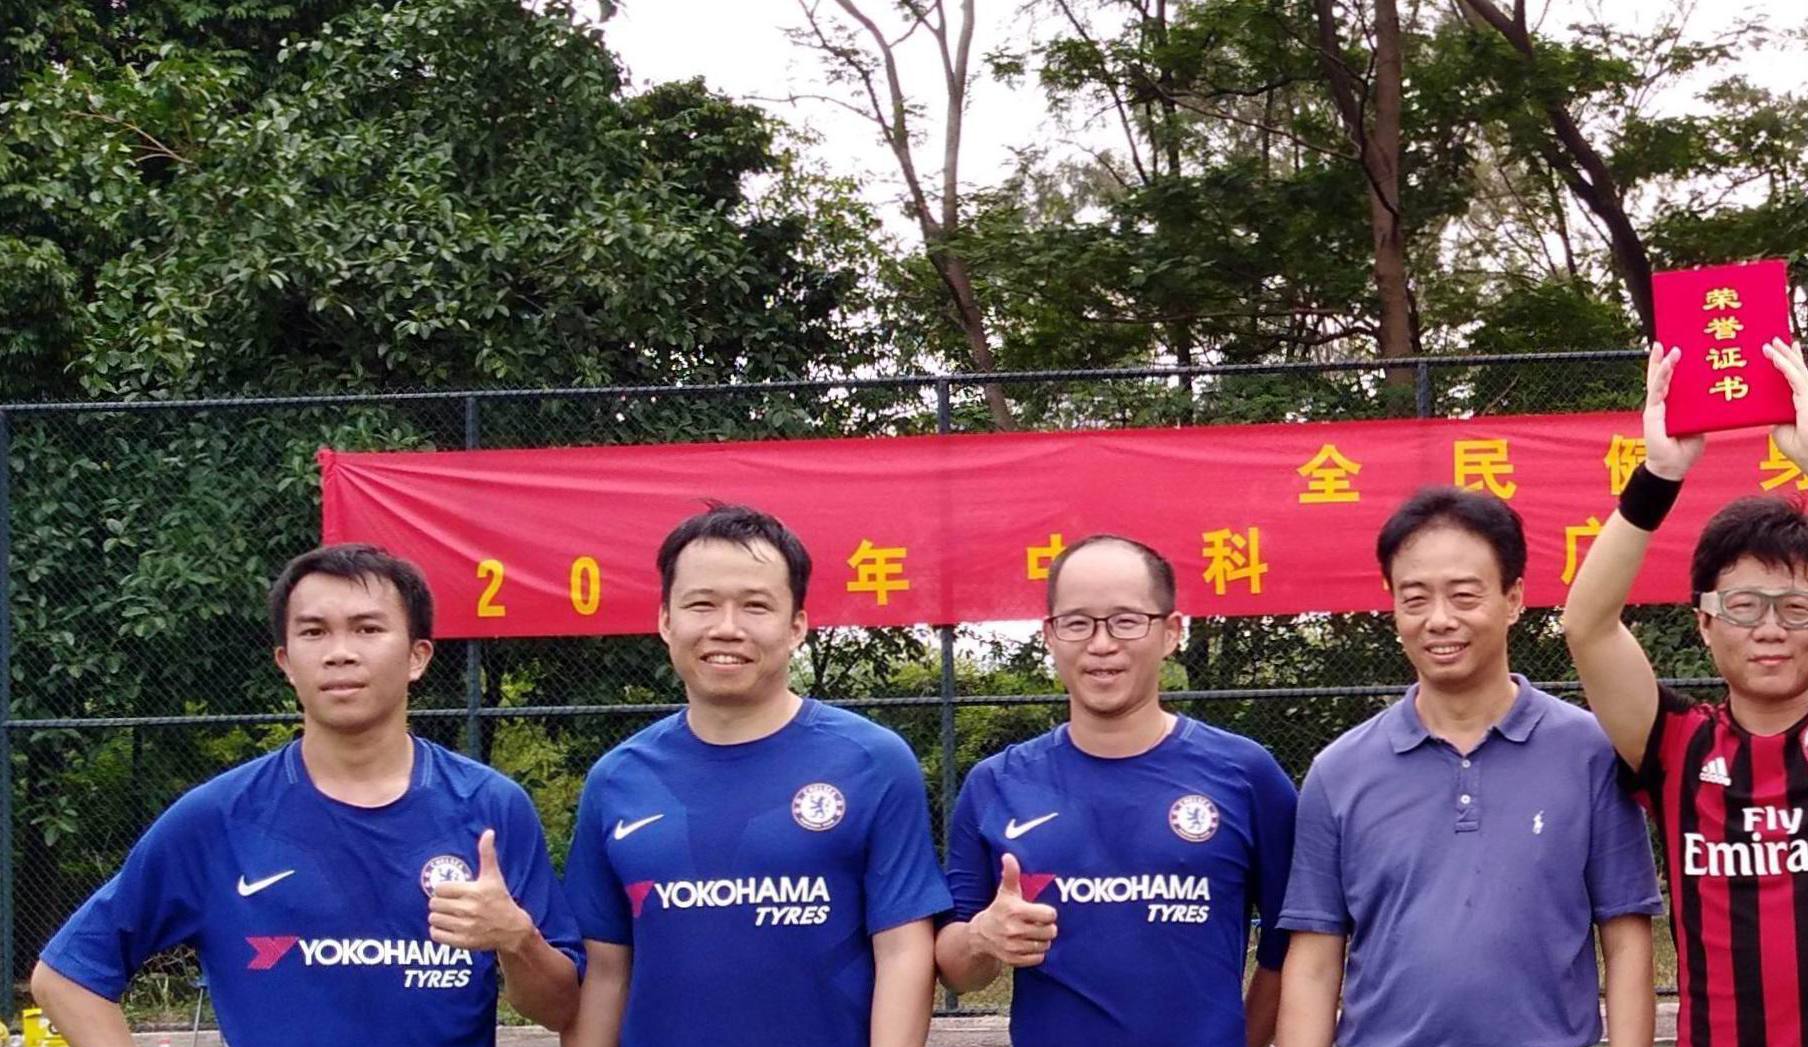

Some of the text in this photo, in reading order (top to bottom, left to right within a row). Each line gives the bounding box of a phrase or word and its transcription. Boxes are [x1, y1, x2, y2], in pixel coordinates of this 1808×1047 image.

[1703, 288, 1749, 401] 荣誉证书
[1741, 806, 1804, 834] Fly
[655, 876, 830, 909] YOKOHAMA
[1055, 874, 1211, 903] YOKOHAMA
[755, 904, 830, 926] TYRES
[1147, 904, 1210, 924] TYRES
[298, 938, 474, 966] YOKOHAMA
[403, 968, 471, 988] TYRES
